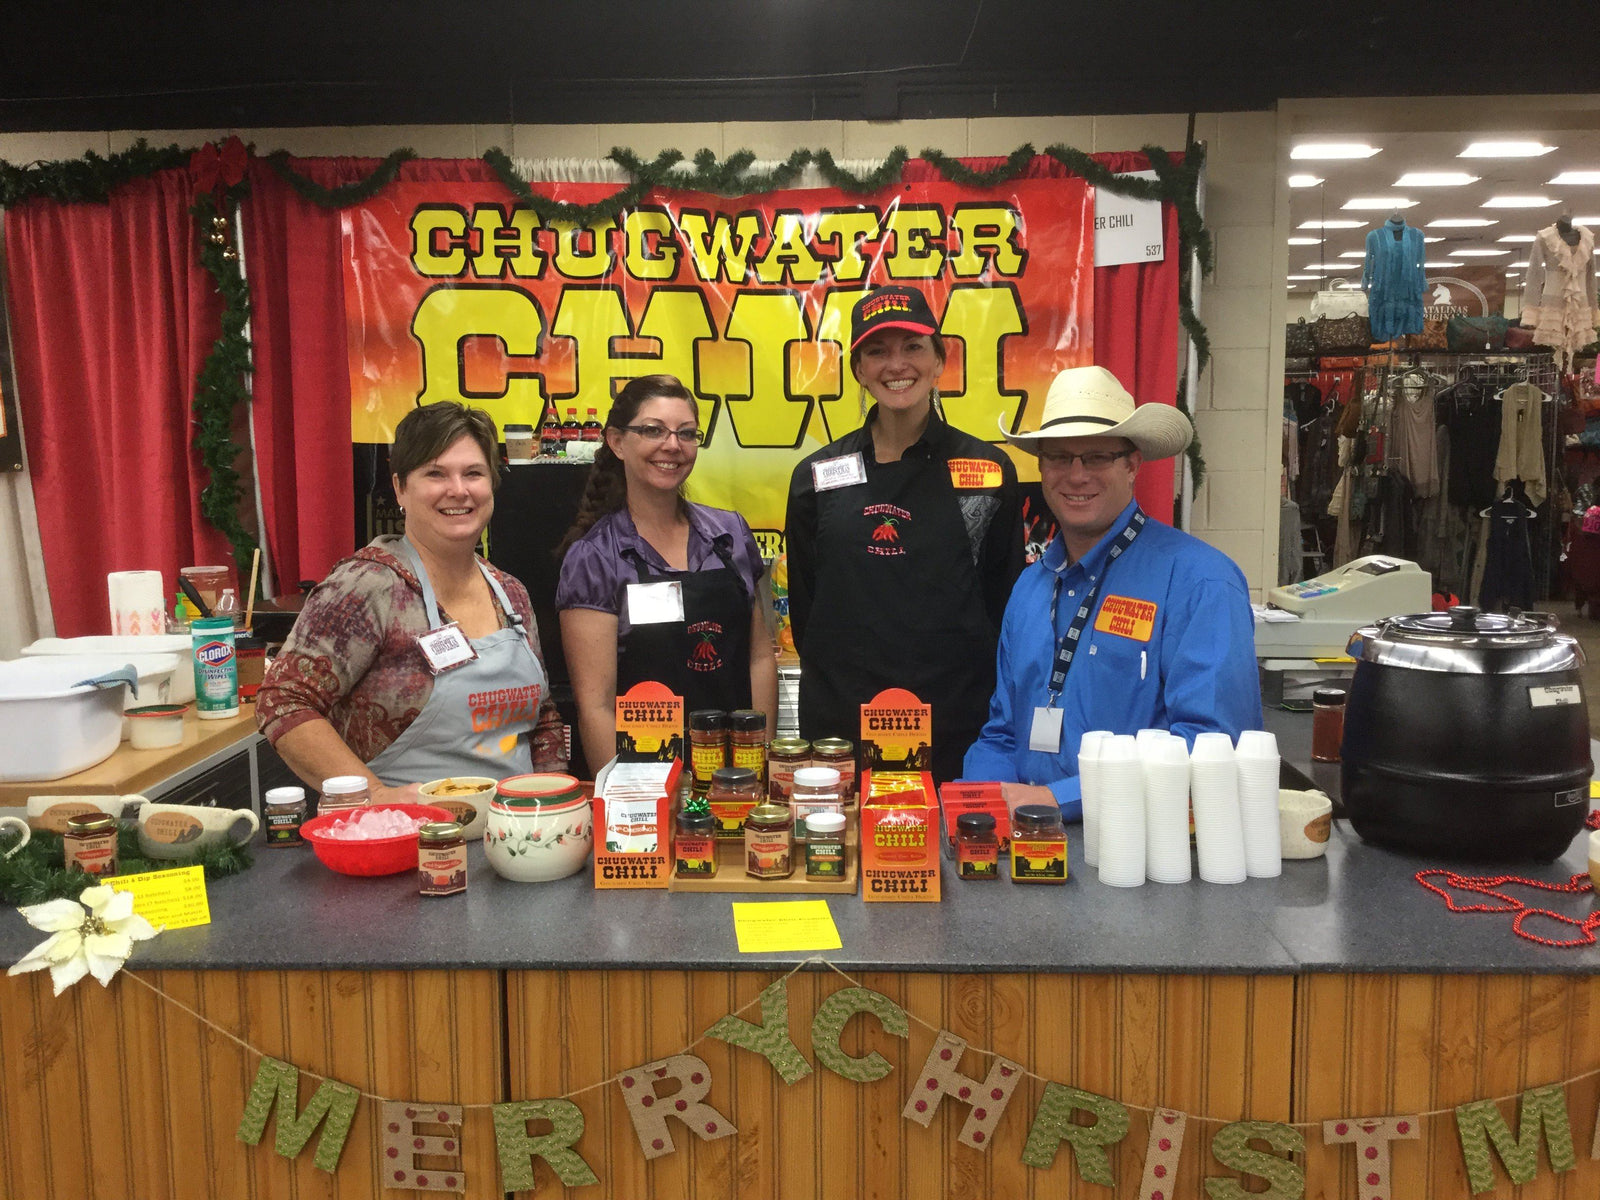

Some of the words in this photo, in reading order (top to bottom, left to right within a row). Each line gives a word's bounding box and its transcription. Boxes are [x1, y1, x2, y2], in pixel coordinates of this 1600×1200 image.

[1110, 214, 1133, 229] CHILI
[410, 203, 1027, 285] CHUGWATER
[1146, 245, 1161, 256] 537
[863, 299, 909, 321] CHILI
[1423, 305, 1468, 314] ATALINAS
[948, 461, 1001, 474] HUGWATER
[959, 473, 985, 487] CHILI
[863, 504, 912, 520] CHUGWATER
[867, 546, 906, 556] CHILI
[1102, 598, 1153, 622] CHUGWATER
[1109, 616, 1134, 635] CHILI
[199, 645, 232, 663] CLOROX
[623, 709, 673, 722] CHILI
[869, 717, 921, 730] CHILI
[874, 834, 925, 847] CHILI
[597, 857, 665, 865] CHUGWATER
[603, 866, 658, 879] CHILI
[866, 870, 936, 878] CHUGWATER
[871, 879, 929, 893] CHILI
[236, 977, 813, 1195] MERRY
[811, 986, 1600, 1200] CHRISTM
